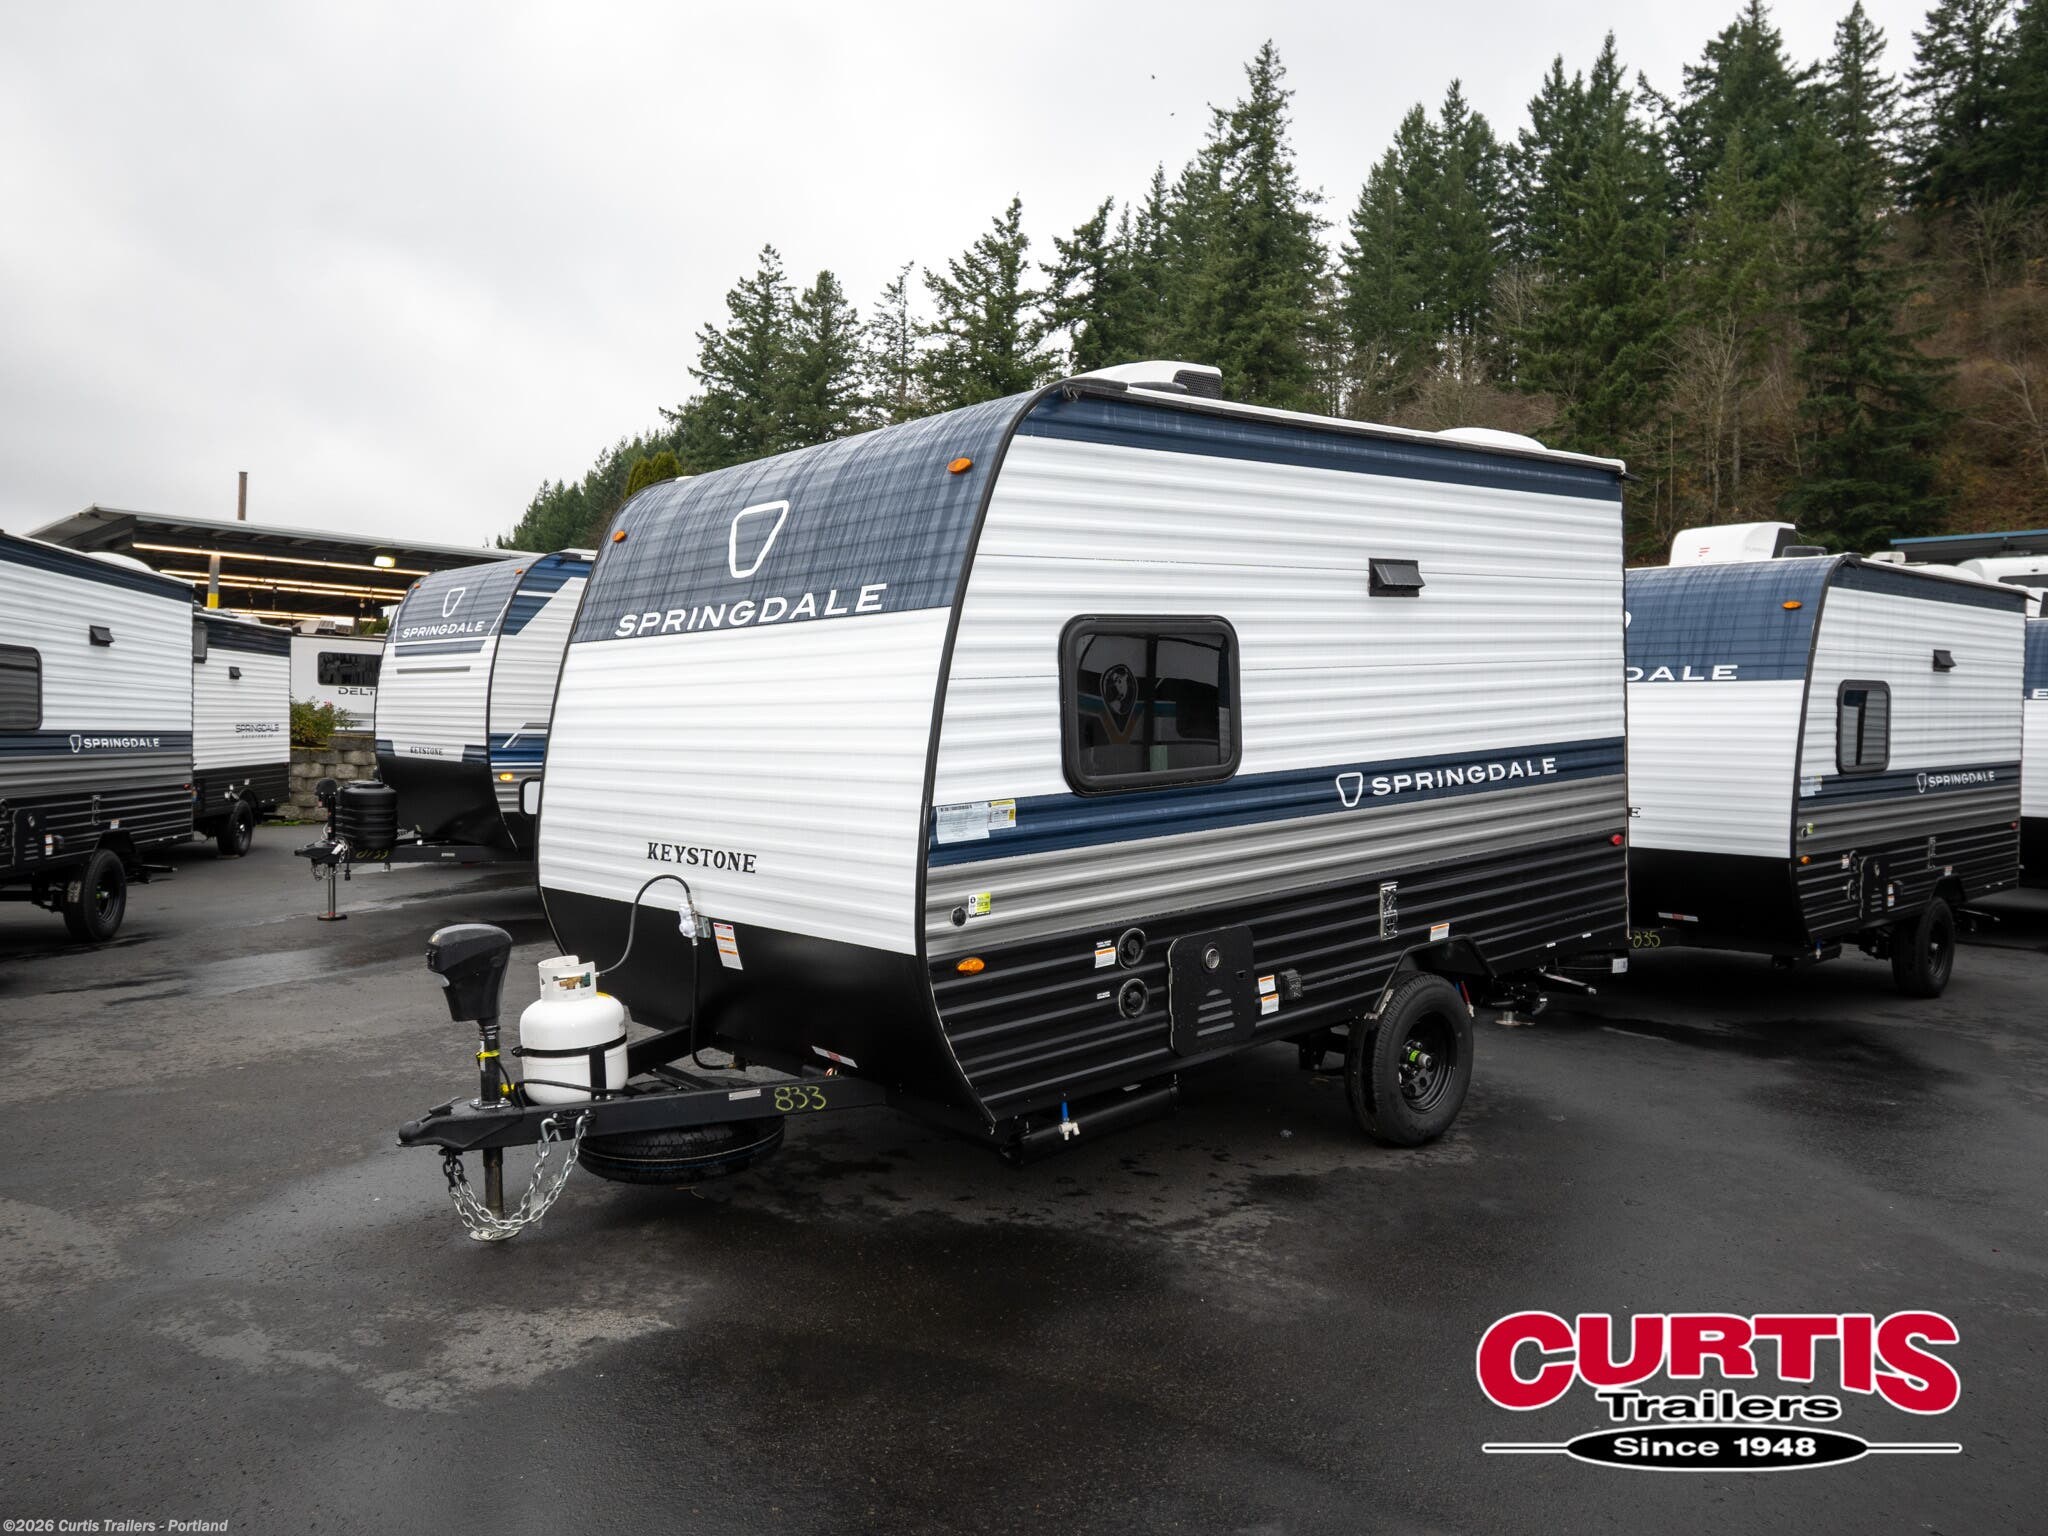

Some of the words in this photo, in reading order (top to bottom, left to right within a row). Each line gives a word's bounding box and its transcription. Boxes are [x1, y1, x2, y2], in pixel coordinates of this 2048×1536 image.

[614, 582, 888, 638] SPRINGDALE
[401, 620, 486, 639] SPRINGDALE
[234, 723, 280, 733] SPRINGDALE
[83, 737, 160, 749] SPRINGDALE
[1371, 757, 1558, 797] SPRINGDALE
[1928, 770, 1995, 788] SPRINGDALE
[647, 841, 757, 874] KEYSTONE
[774, 1085, 827, 1111] 833
